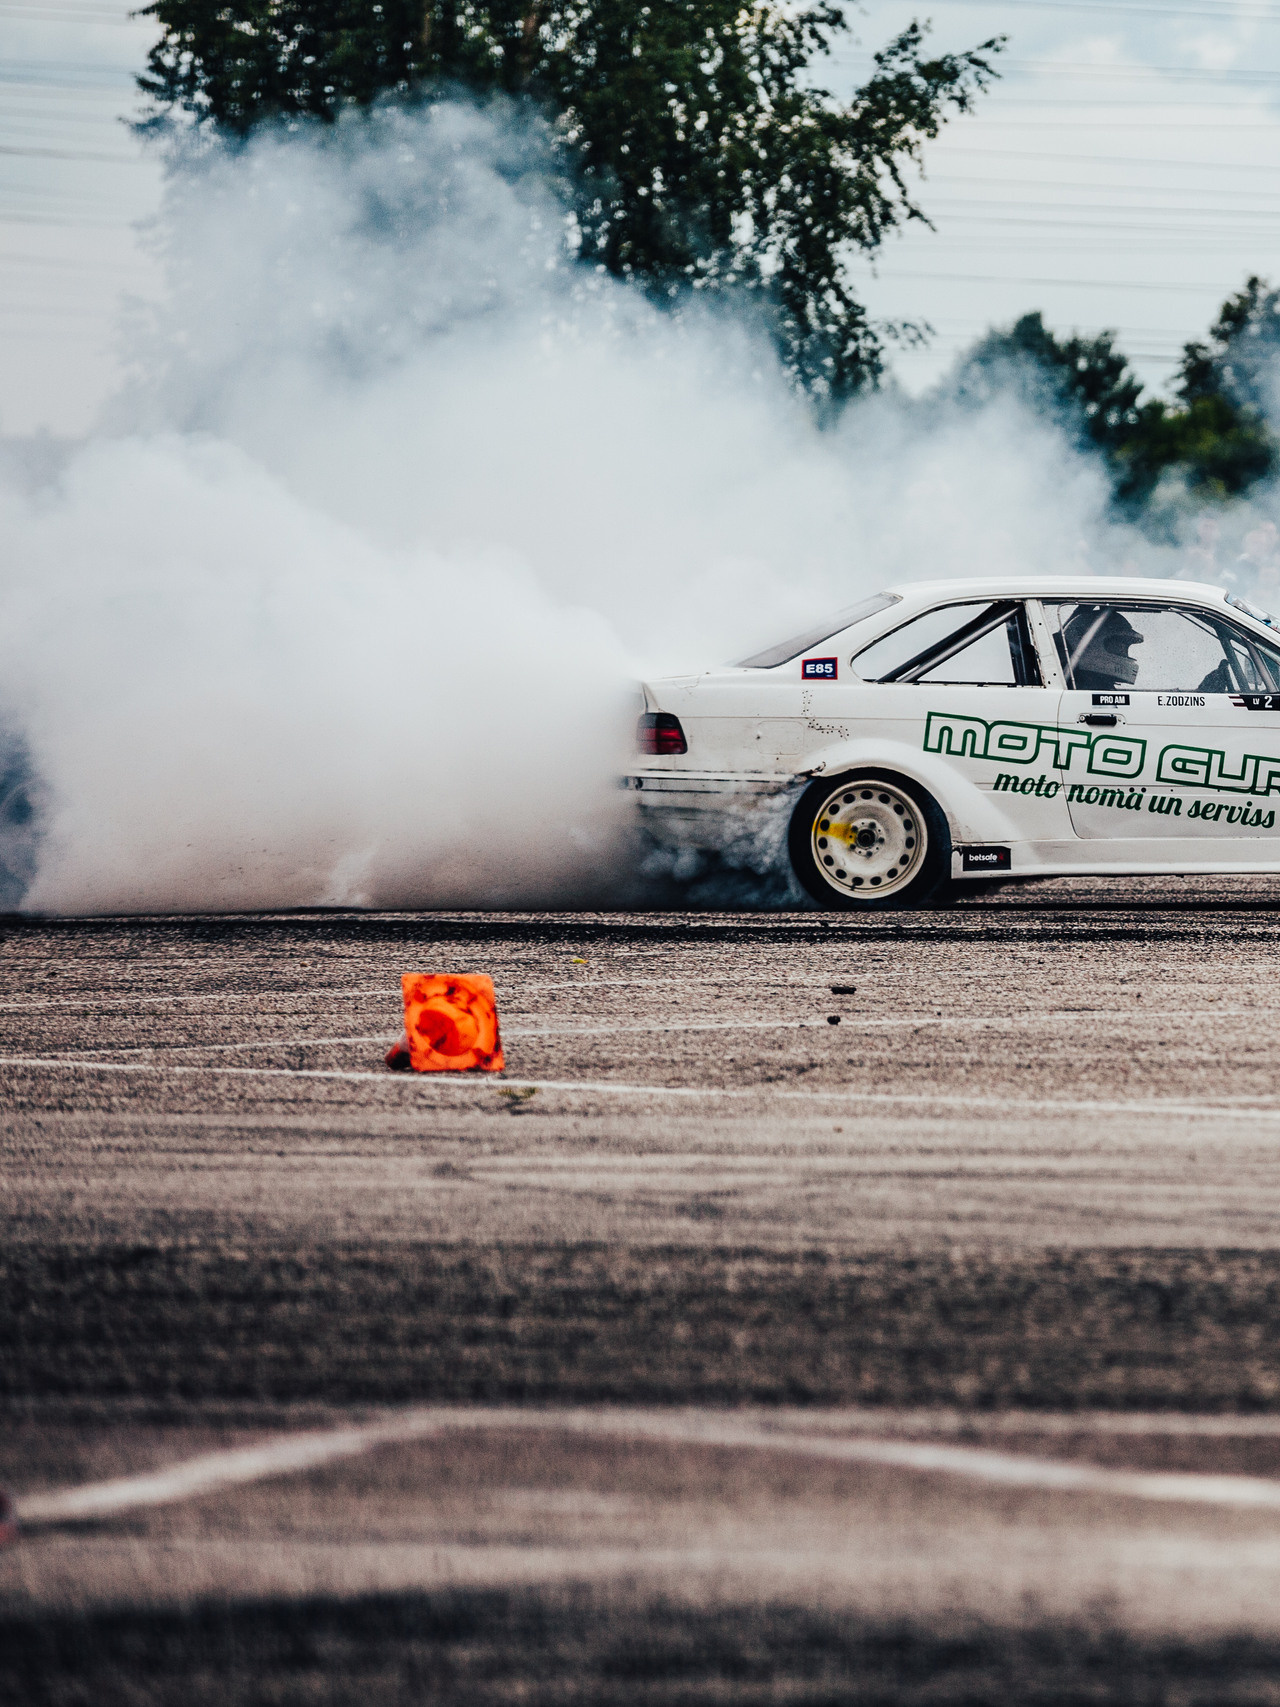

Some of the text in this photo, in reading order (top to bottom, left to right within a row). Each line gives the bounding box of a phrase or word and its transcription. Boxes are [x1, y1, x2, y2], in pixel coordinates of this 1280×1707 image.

[805, 663, 834, 674] E85
[1100, 695, 1126, 704] PRO AM
[1157, 695, 1206, 707] E.ZODZINS
[1252, 695, 1273, 708] LV 2
[922, 711, 1148, 780] MOTO
[993, 773, 1063, 799] moto
[1148, 795, 1183, 817] un
[1187, 800, 1276, 829] serviss
[968, 852, 998, 862] betsafe
